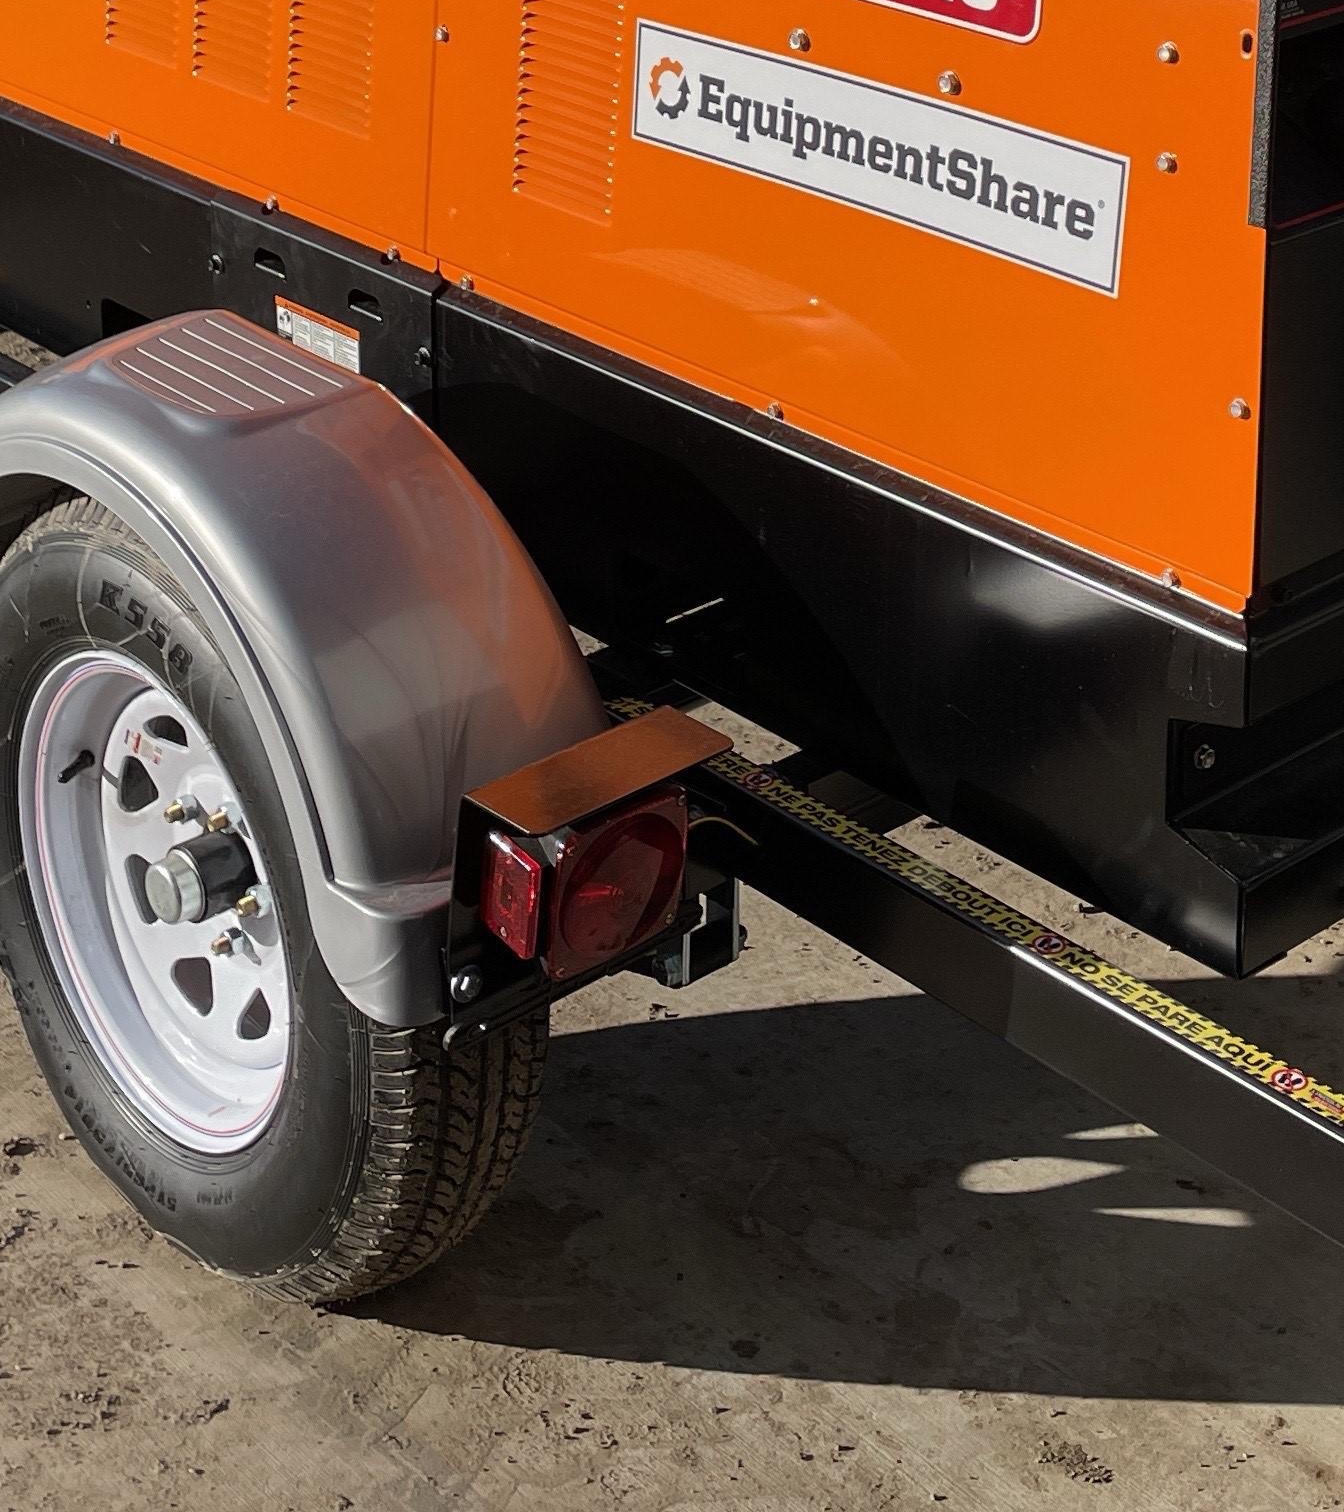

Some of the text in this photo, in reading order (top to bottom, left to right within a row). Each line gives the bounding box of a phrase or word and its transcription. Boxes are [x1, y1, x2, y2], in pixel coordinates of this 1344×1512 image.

[697, 72, 1096, 242] EquipmentShare
[767, 785, 1034, 938] NE PAS TENEZ DEBOUT ICI
[1062, 951, 1101, 976] NO
[1101, 973, 1135, 997] SE
[1135, 994, 1208, 1035] PARE
